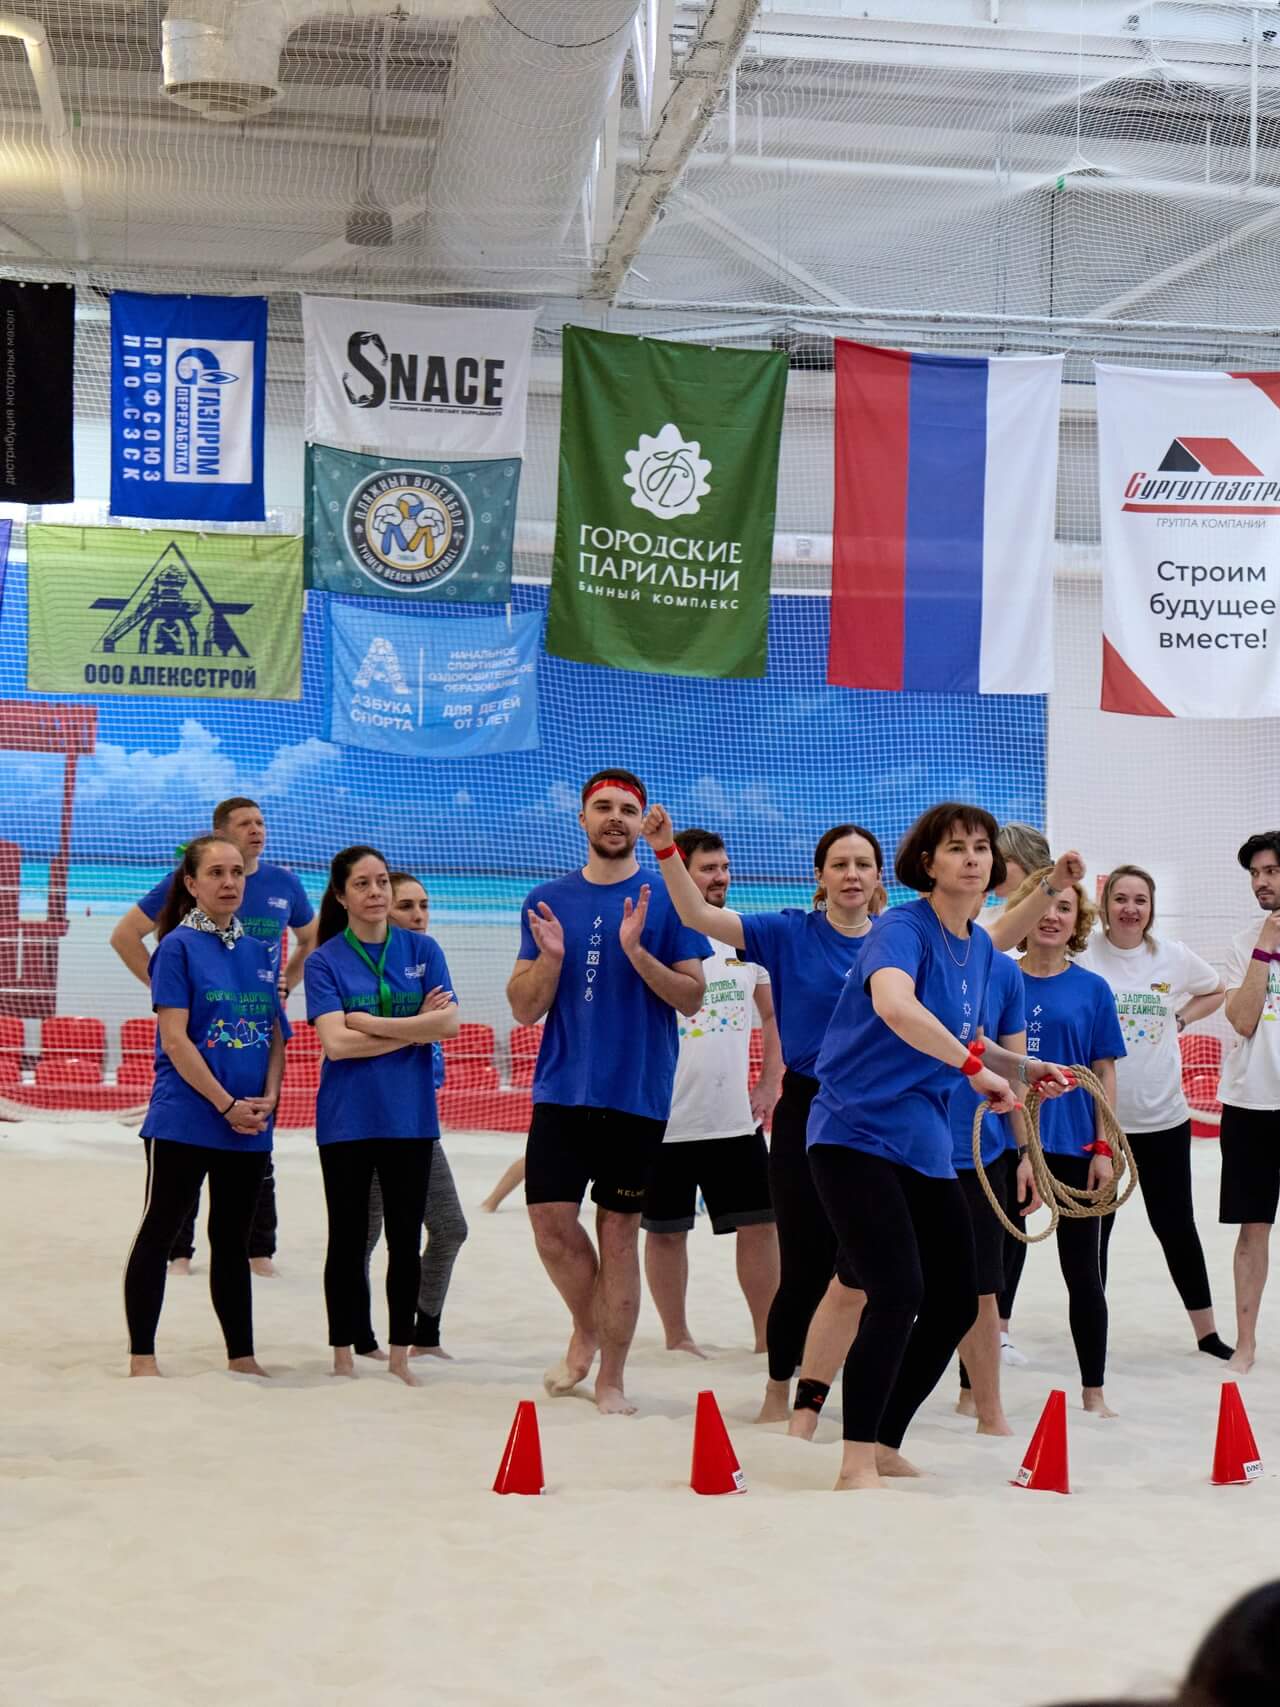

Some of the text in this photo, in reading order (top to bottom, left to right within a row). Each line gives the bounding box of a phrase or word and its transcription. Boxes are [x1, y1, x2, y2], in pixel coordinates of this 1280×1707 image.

[342, 331, 505, 408] SNACE
[4, 309, 17, 486] дистрибуция моторных масел
[143, 336, 162, 482] ПРОФСОЮЗ
[175, 386, 190, 474] ПЕРЕРАБОТКА
[196, 387, 221, 476] ГАЗПРОМ
[353, 475, 465, 527] ПЛЯЖНЫЙ ВОЛЕЙБОЛ
[1156, 517, 1199, 529] ГРУППА
[579, 524, 743, 564] ГОРОДСКИЕ
[578, 551, 741, 592] ПАРИЛЬНИ
[1157, 560, 1267, 587] Строим
[578, 581, 740, 610] БАННЫЙ КОМПЛЕКС
[1150, 592, 1277, 621] будущее
[1159, 629, 1268, 649] вместе!
[84, 663, 257, 690] ООО АЛЕКССТРОЙ
[351, 693, 413, 716] АЗБУКА
[443, 695, 521, 718] ДЛЯ ДЕТЕЙ
[350, 709, 414, 732] СПОРТА
[454, 718, 473, 730] ОТ
[485, 713, 512, 727] ЛЕТ
